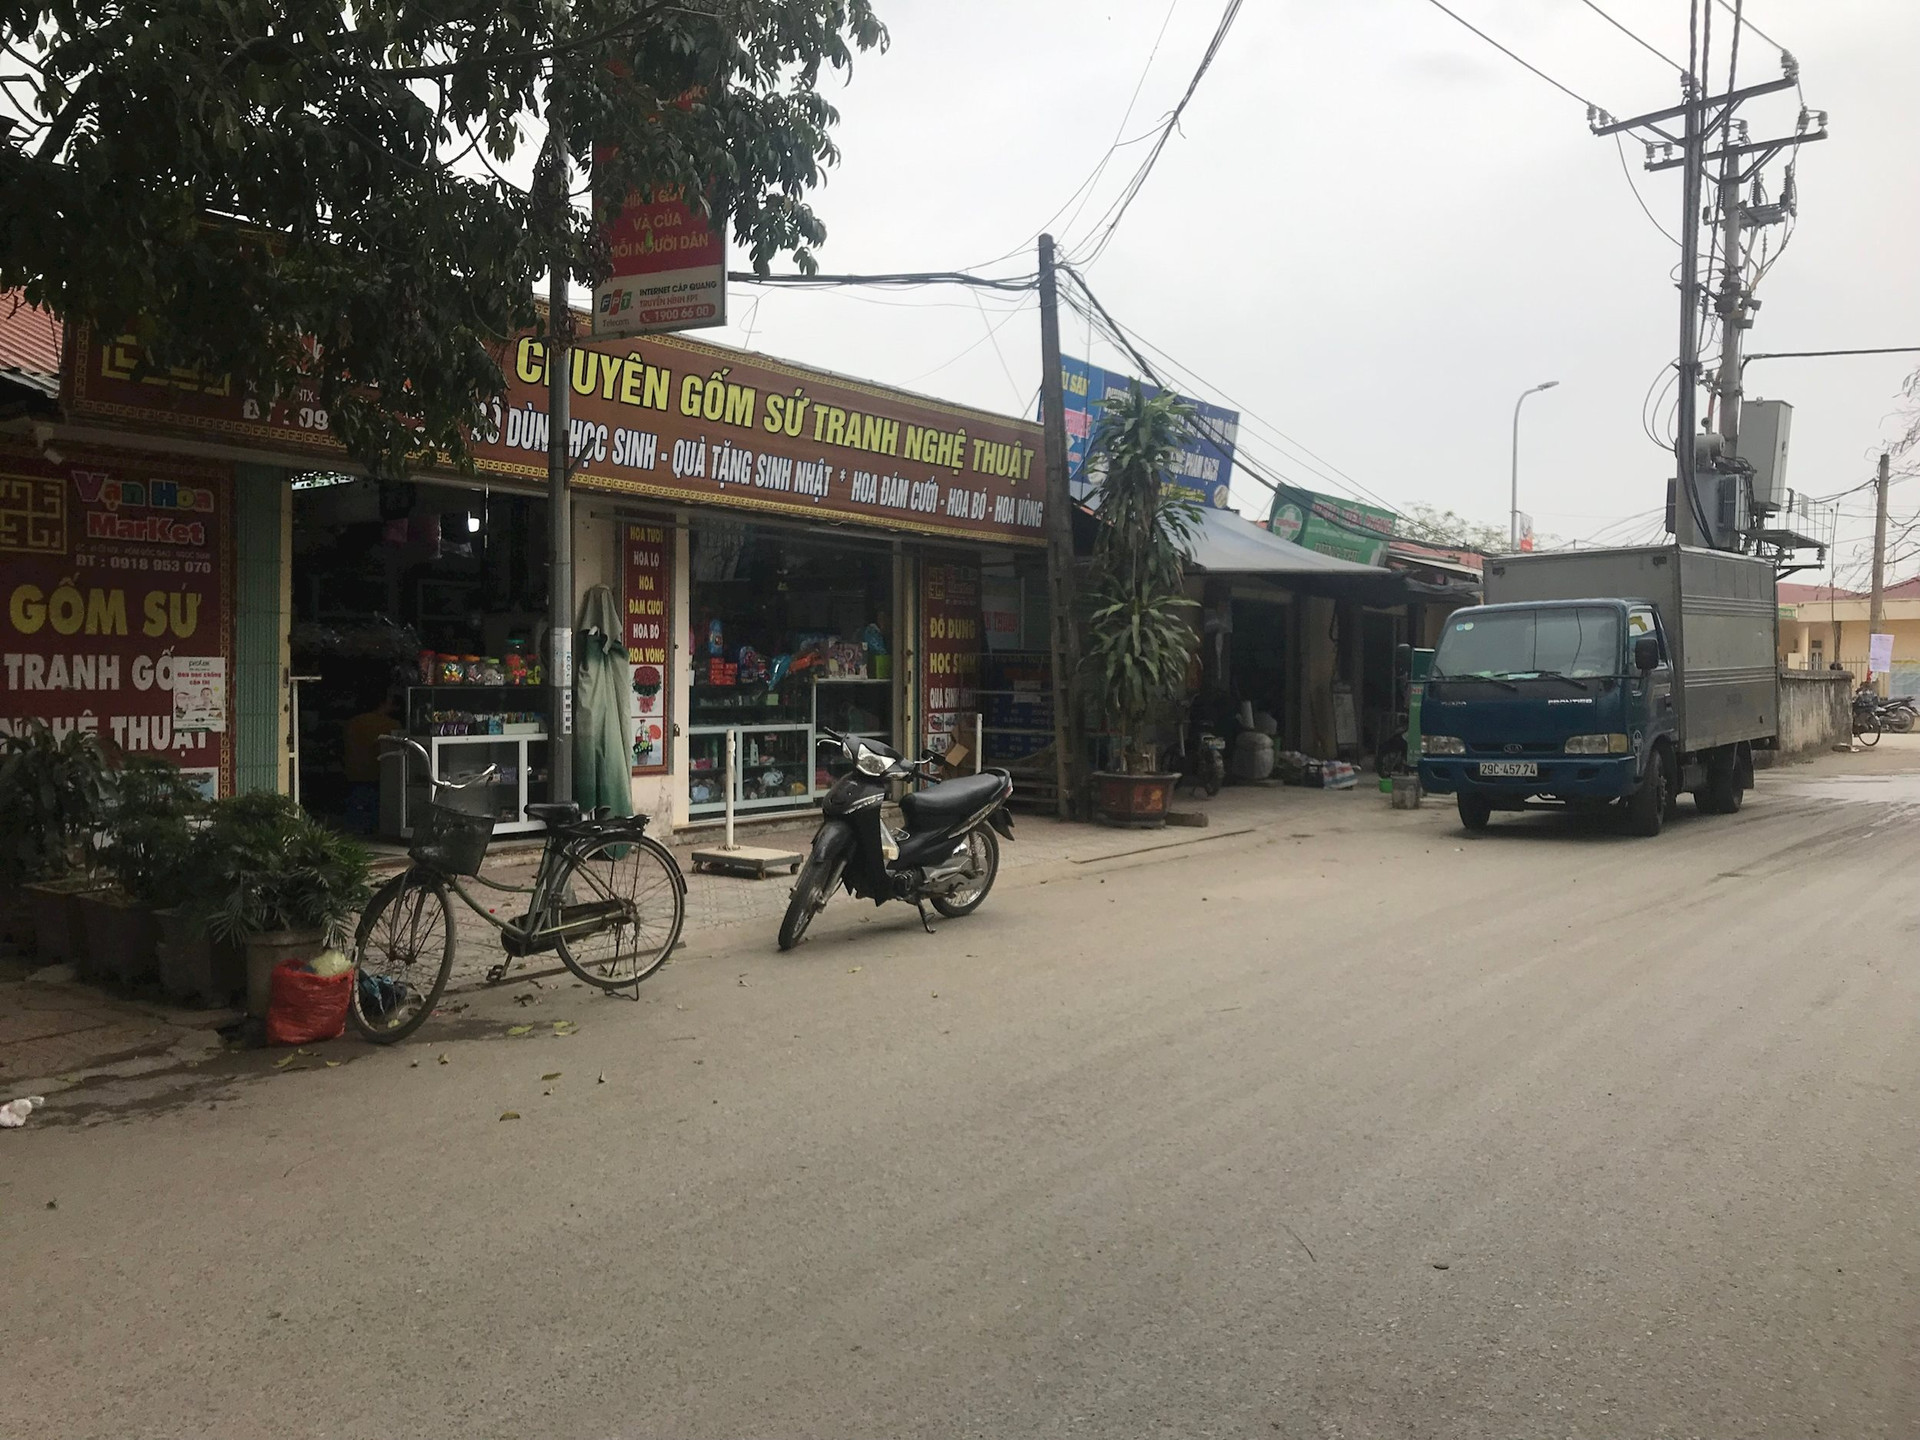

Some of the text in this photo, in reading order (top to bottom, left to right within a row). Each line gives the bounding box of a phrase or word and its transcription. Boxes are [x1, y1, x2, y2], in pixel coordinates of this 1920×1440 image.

[653, 209, 682, 228] CỦA
[680, 231, 709, 248] DÂN
[639, 286, 671, 297] INTERNET
[689, 282, 717, 291] QUANG
[600, 289, 632, 316] FPT
[667, 295, 686, 306] HÌNH
[687, 294, 699, 304] FPT
[655, 306, 710, 321] 1900 66 00
[602, 319, 630, 328] Telecom
[679, 367, 757, 428] GỐM
[763, 387, 811, 438] SỨ
[813, 403, 900, 456] TRANH
[903, 424, 967, 476] NGHỆ
[972, 439, 1036, 486] THUẬT
[505, 401, 550, 453] DÙN
[568, 419, 609, 468] HỌC
[612, 427, 658, 470] SINH
[672, 435, 707, 479] QUÀ
[711, 439, 752, 489] TẶNG
[755, 453, 793, 492] SINH
[793, 458, 834, 503] NHẬT
[71, 470, 214, 512] Vạn Hoa
[851, 470, 877, 504] HOA
[880, 471, 910, 509] ĐÁM
[910, 475, 939, 514] CƯỚI
[947, 488, 969, 519] HOA
[971, 487, 987, 521] BÓ
[994, 496, 1014, 525] HOA
[1017, 493, 1043, 528] VÒNG
[630, 526, 645, 542] HOA
[75, 554, 96, 567] ĐT
[110, 555, 149, 571] 0918
[153, 558, 181, 573] 953
[185, 561, 212, 574] 070
[633, 551, 660, 570] HOA LỌ
[639, 575, 654, 591] HOA
[9, 571, 202, 638] GỐM SỨ
[629, 596, 645, 615] ĐÁM
[633, 621, 660, 639] HOA BÓ
[929, 614, 945, 638] ĐỒ
[629, 648, 644, 663] HOA
[4, 652, 120, 690] TRANH
[929, 653, 951, 679] HỌC
